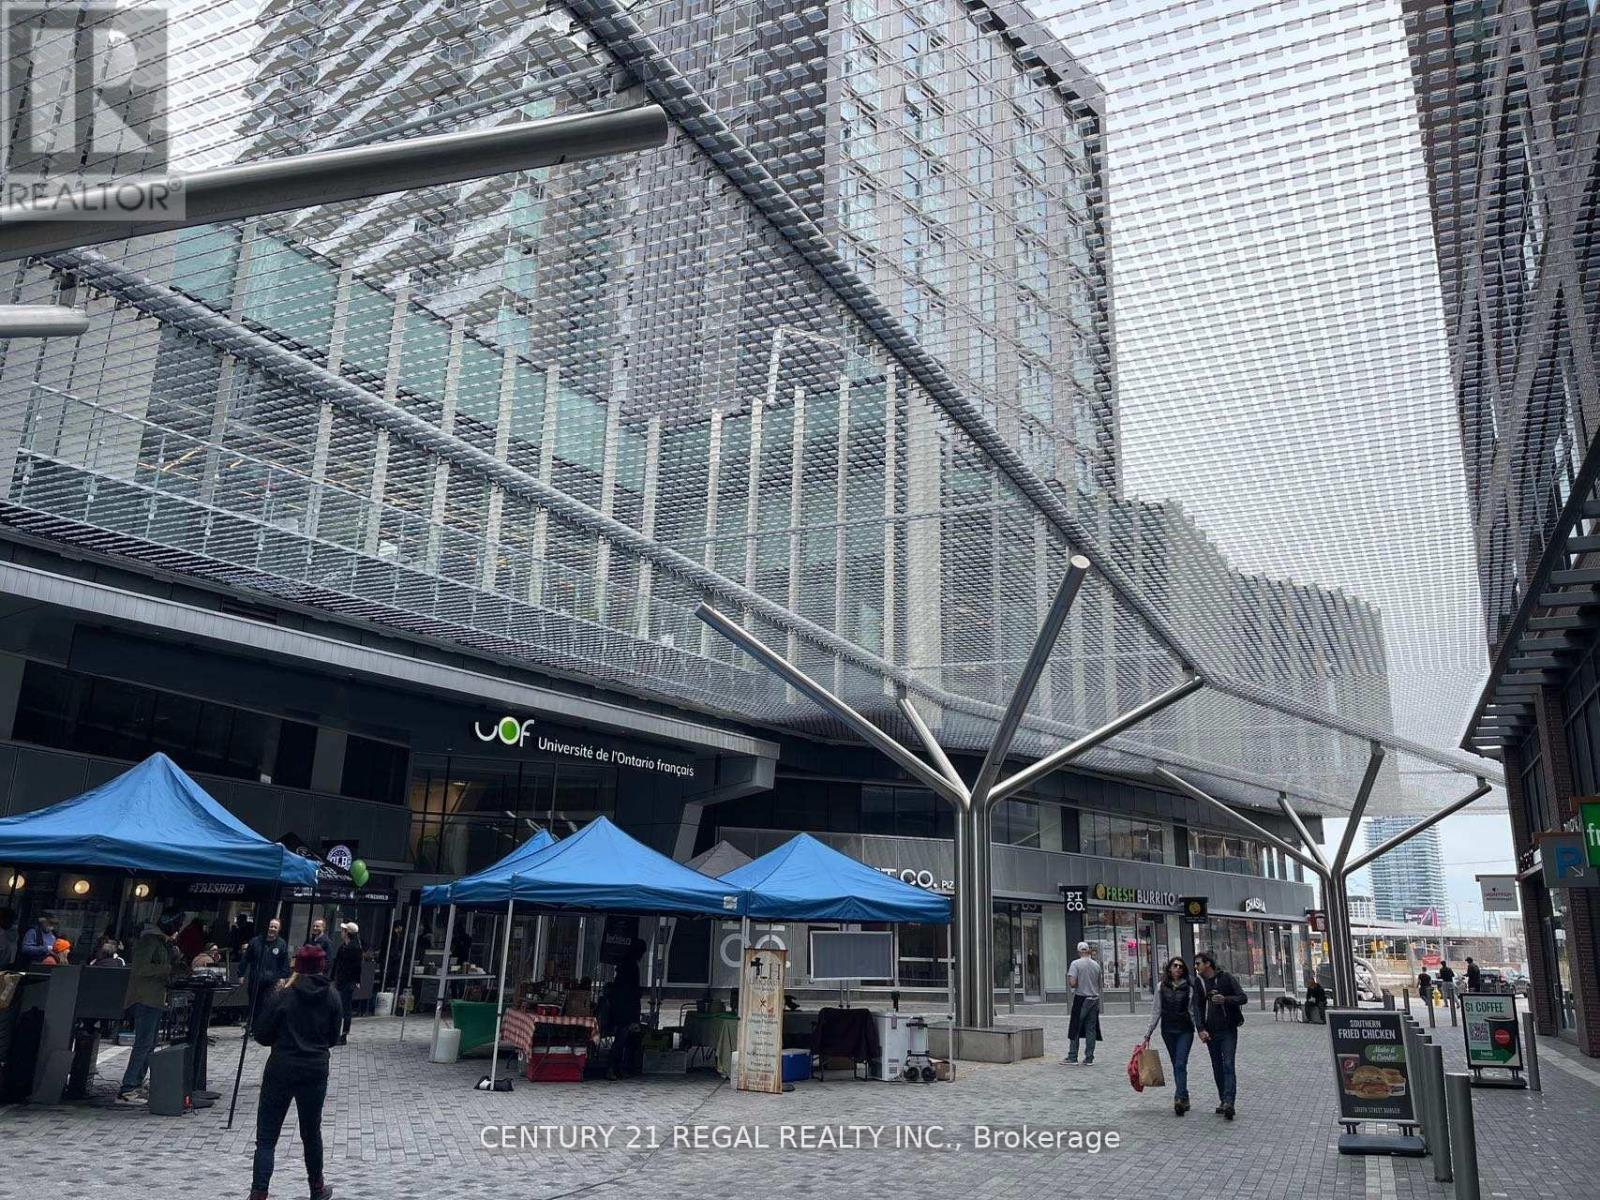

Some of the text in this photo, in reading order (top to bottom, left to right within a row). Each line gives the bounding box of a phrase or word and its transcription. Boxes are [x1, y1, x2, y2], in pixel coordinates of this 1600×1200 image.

[538, 736, 695, 778] Université de l'Ontario français
[1106, 886, 1136, 903] FRESH
[1136, 888, 1176, 906] BURRITO
[1066, 902, 1085, 912] CO.
[1476, 1002, 1504, 1013] COFFEE
[1349, 1019, 1381, 1028] SOUTHERN
[1338, 1028, 1396, 1040] FRIED CHICKEN
